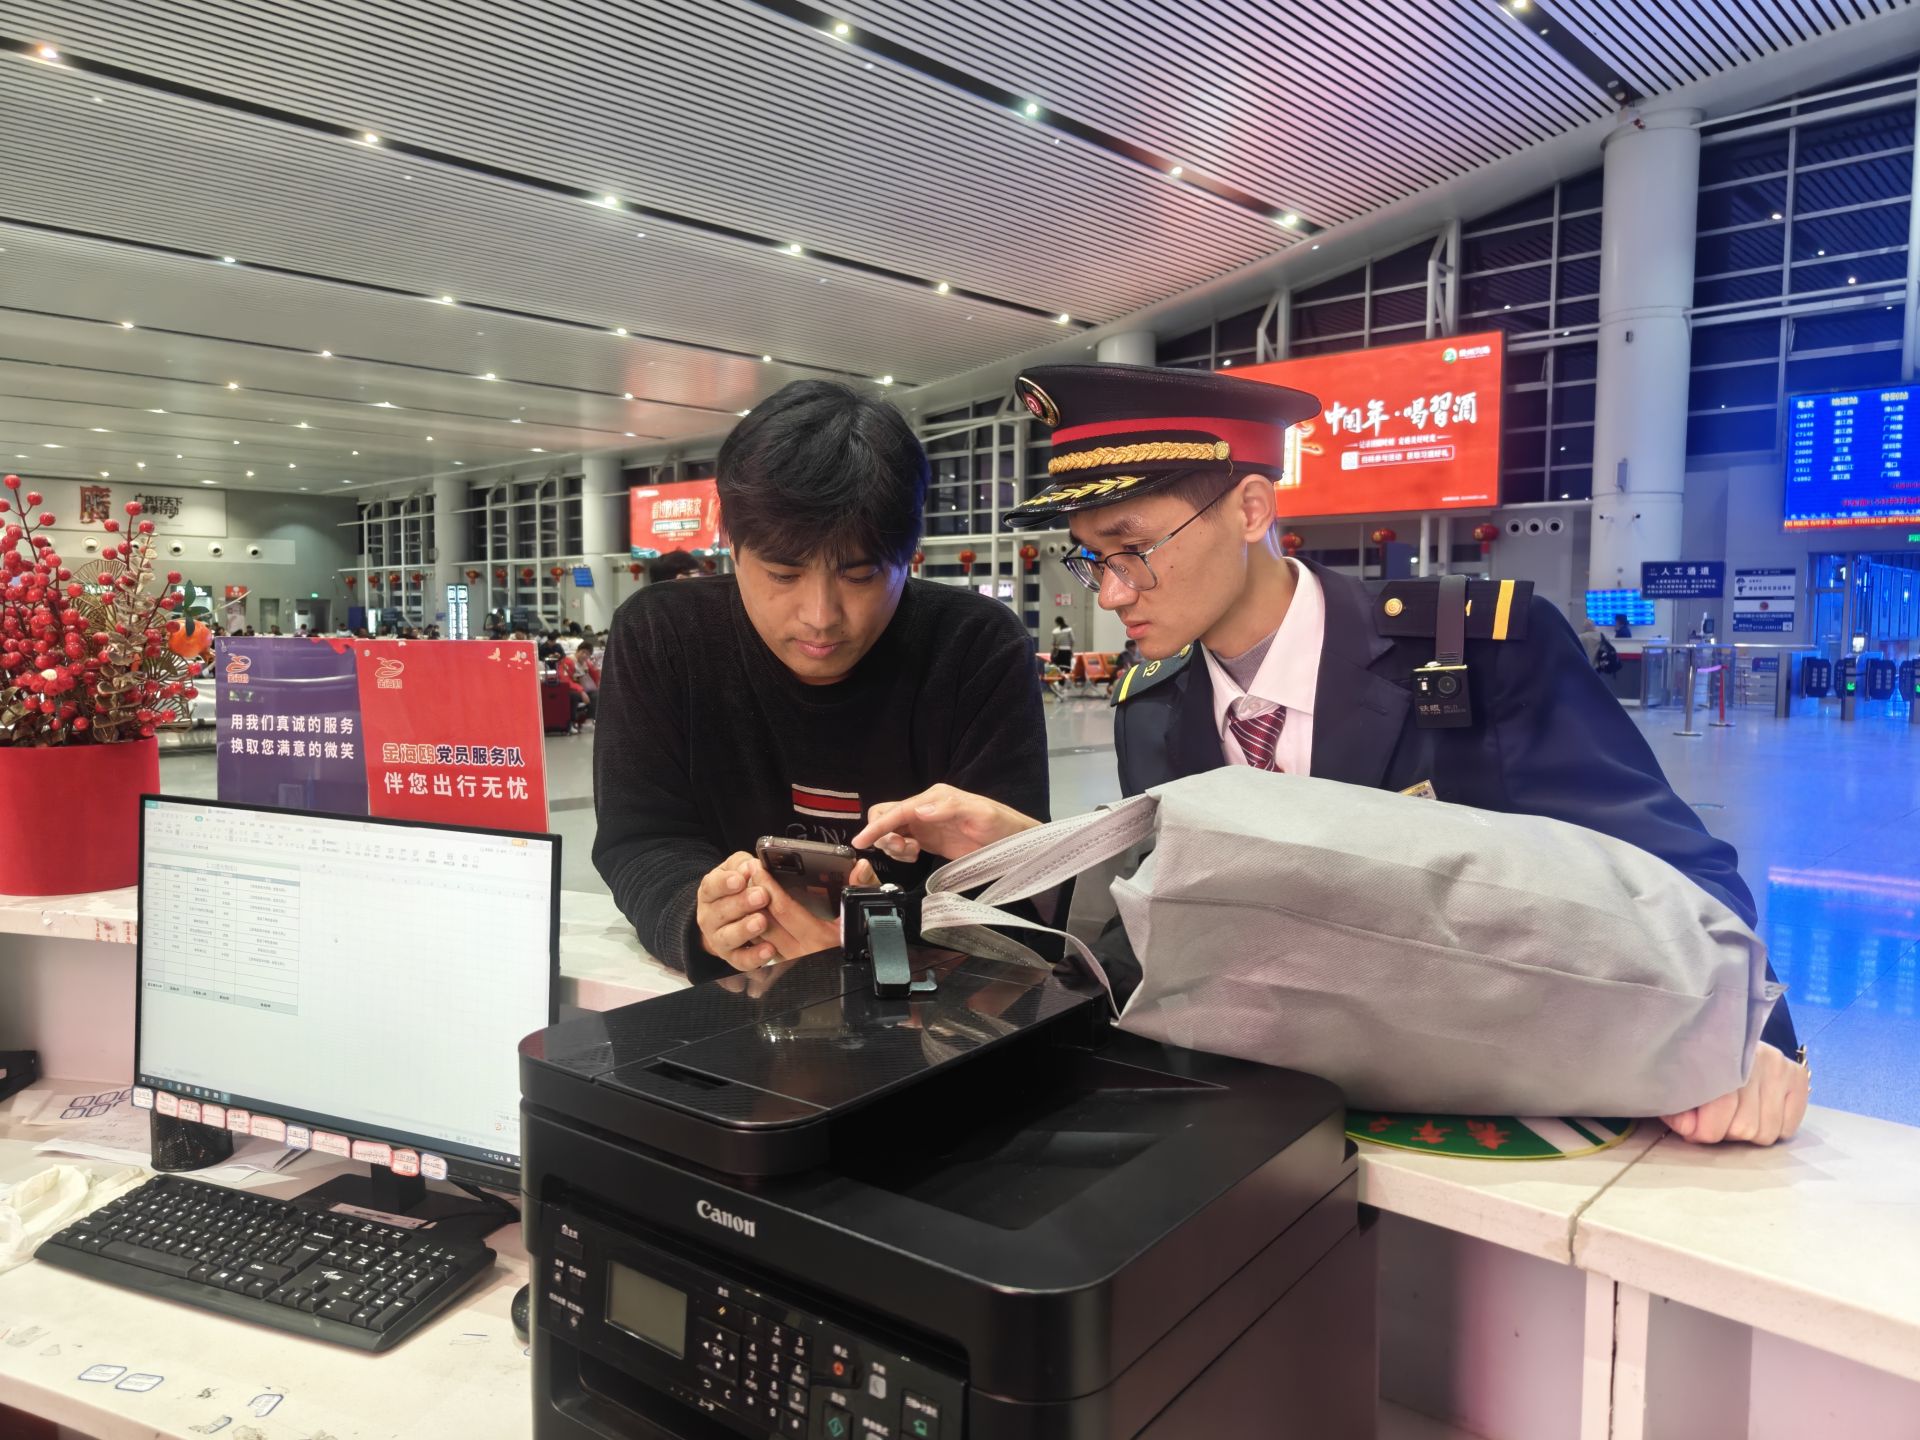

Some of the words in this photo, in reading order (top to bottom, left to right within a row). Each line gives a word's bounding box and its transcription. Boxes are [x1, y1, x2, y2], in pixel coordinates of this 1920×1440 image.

[1661, 566, 1710, 576] 人工通道
[230, 714, 354, 735] 用我们真诚的服务
[231, 737, 355, 760] 换取您满意的微笑
[382, 743, 525, 767] 金海鸥党员服务队
[384, 772, 529, 800] 伴您出行无忧
[696, 1200, 756, 1238] Canon
